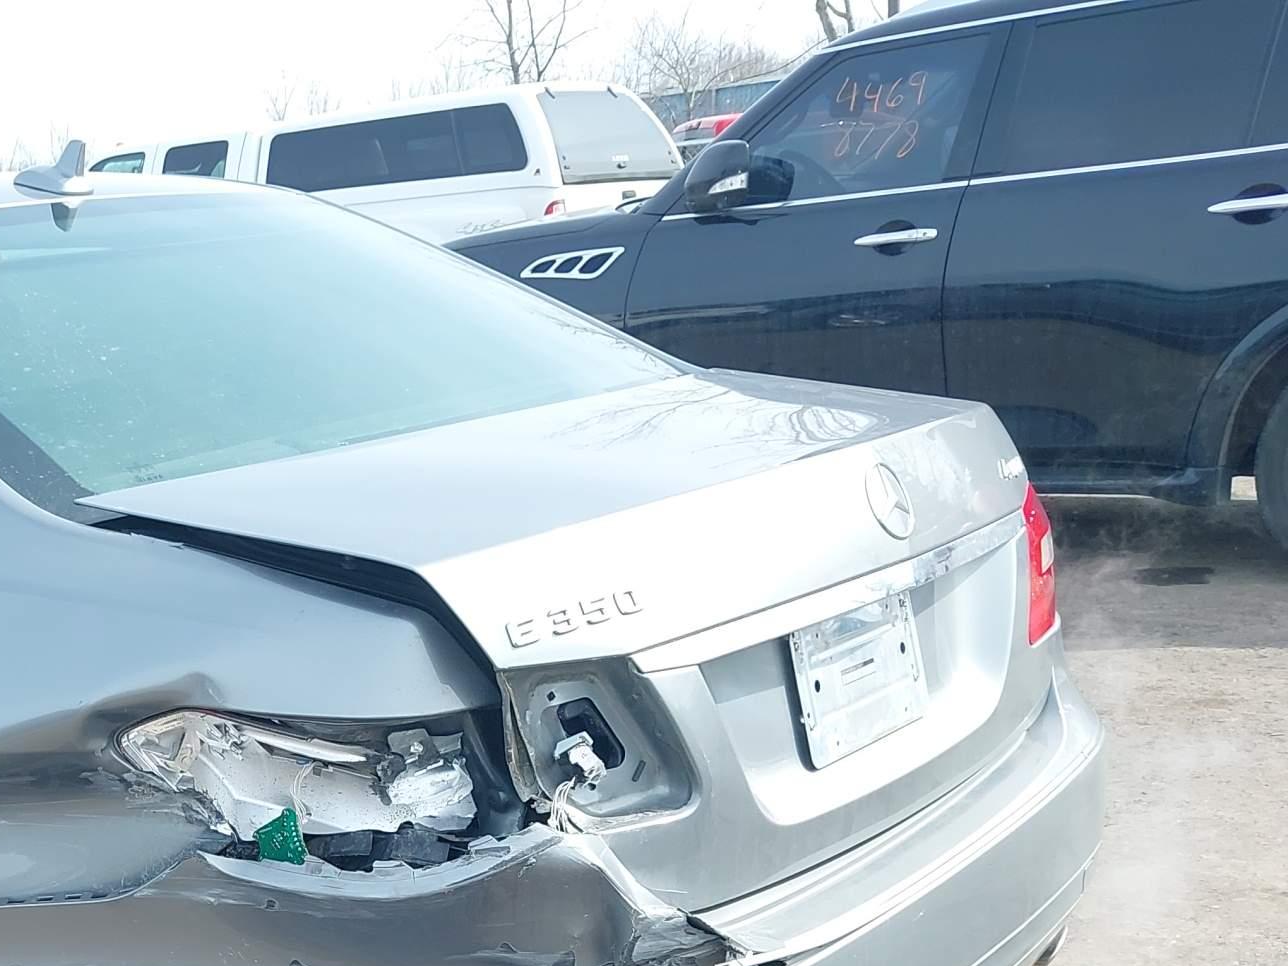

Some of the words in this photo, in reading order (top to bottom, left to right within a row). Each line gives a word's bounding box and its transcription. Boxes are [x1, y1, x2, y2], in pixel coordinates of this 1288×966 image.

[835, 69, 928, 113] 4469
[834, 119, 919, 160] 8778
[504, 617, 541, 649] E
[546, 590, 644, 637] 350
